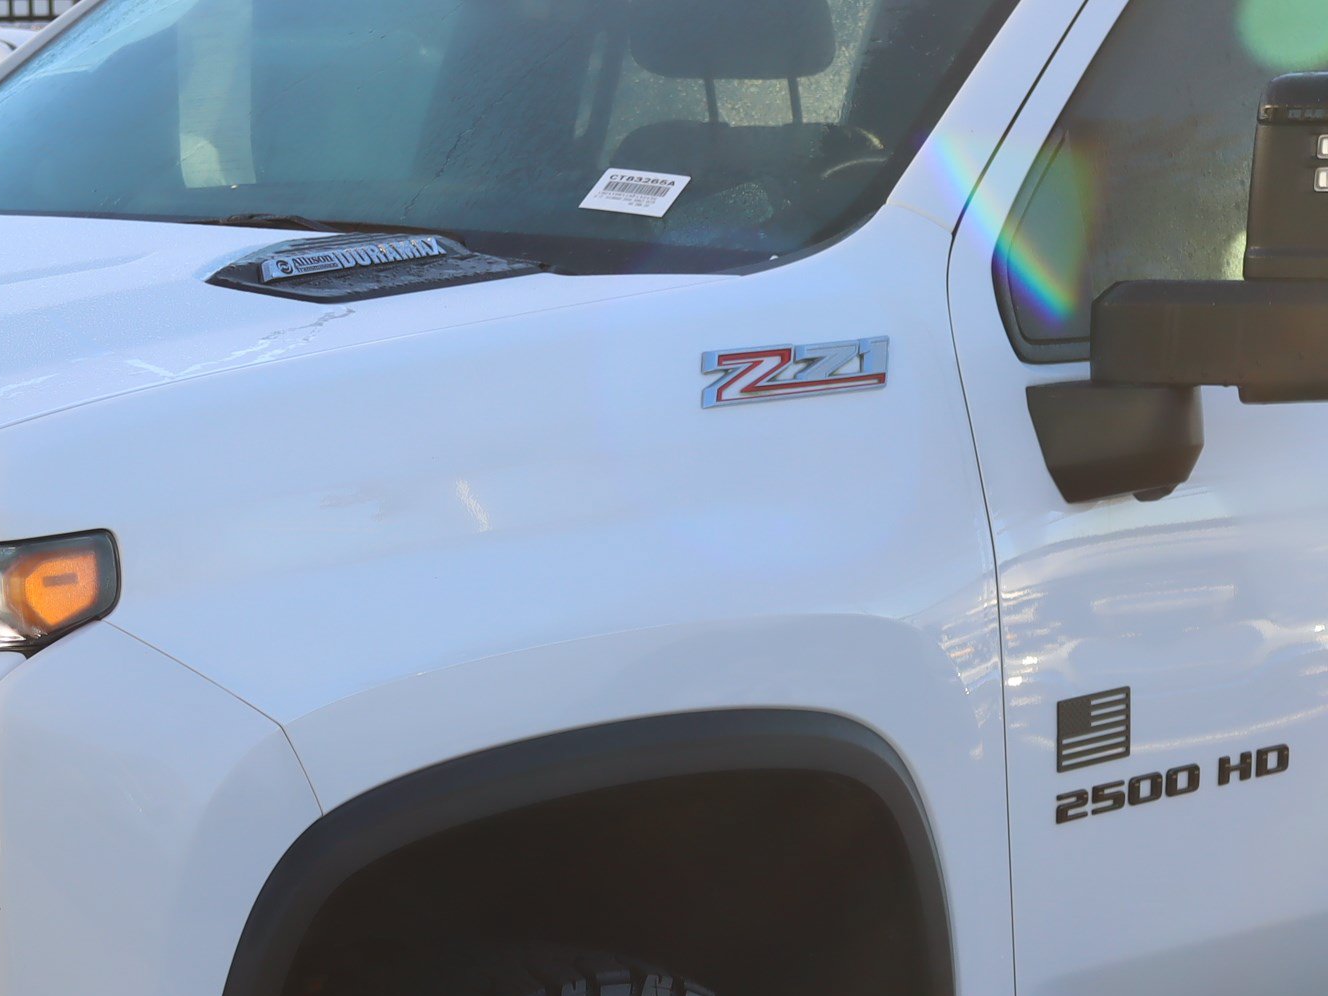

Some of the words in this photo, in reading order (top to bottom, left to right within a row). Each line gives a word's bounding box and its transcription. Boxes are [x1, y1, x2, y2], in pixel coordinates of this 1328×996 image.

[291, 254, 334, 266] Allison
[337, 237, 447, 269] DURAMAX
[700, 335, 889, 409] Z71
[1056, 763, 1200, 824] 2500
[1218, 743, 1290, 786] HD
